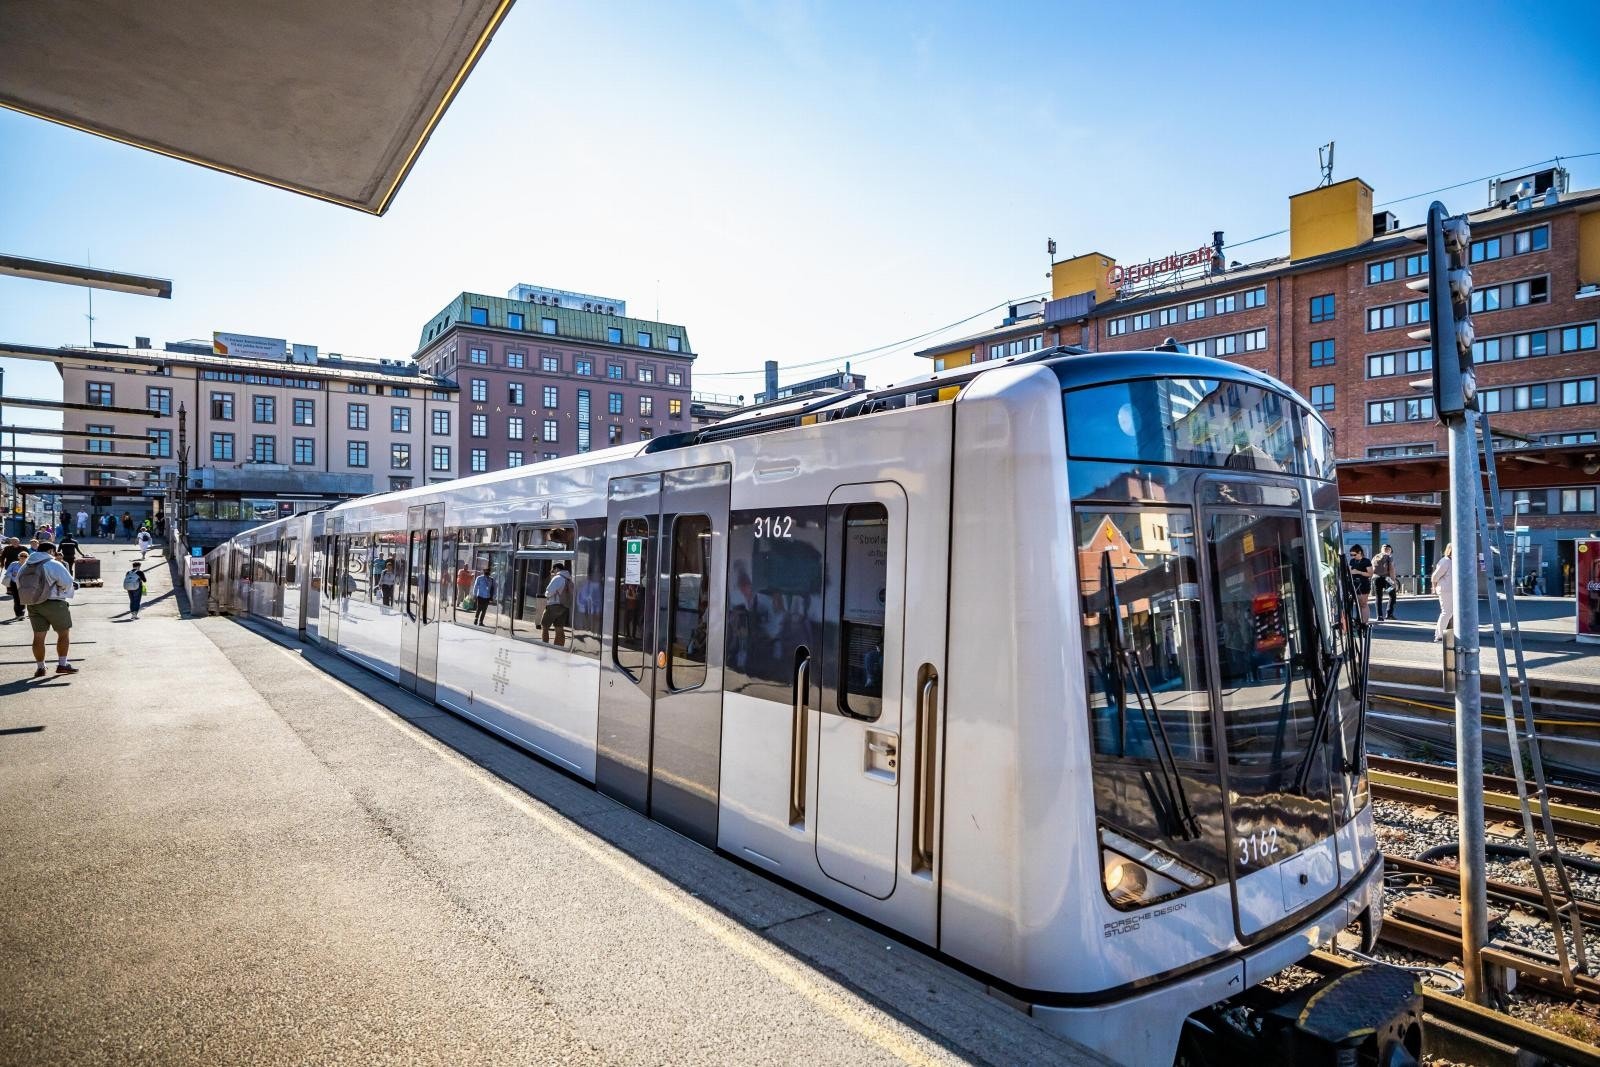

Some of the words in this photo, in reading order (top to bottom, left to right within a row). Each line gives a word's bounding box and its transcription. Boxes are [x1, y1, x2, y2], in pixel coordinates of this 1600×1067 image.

[754, 515, 792, 539] 3162
[1238, 826, 1279, 865] 3162
[1103, 912, 1151, 930] PORSCHE
[1153, 900, 1187, 917] DESIGN
[1104, 923, 1140, 938] STUDIO
